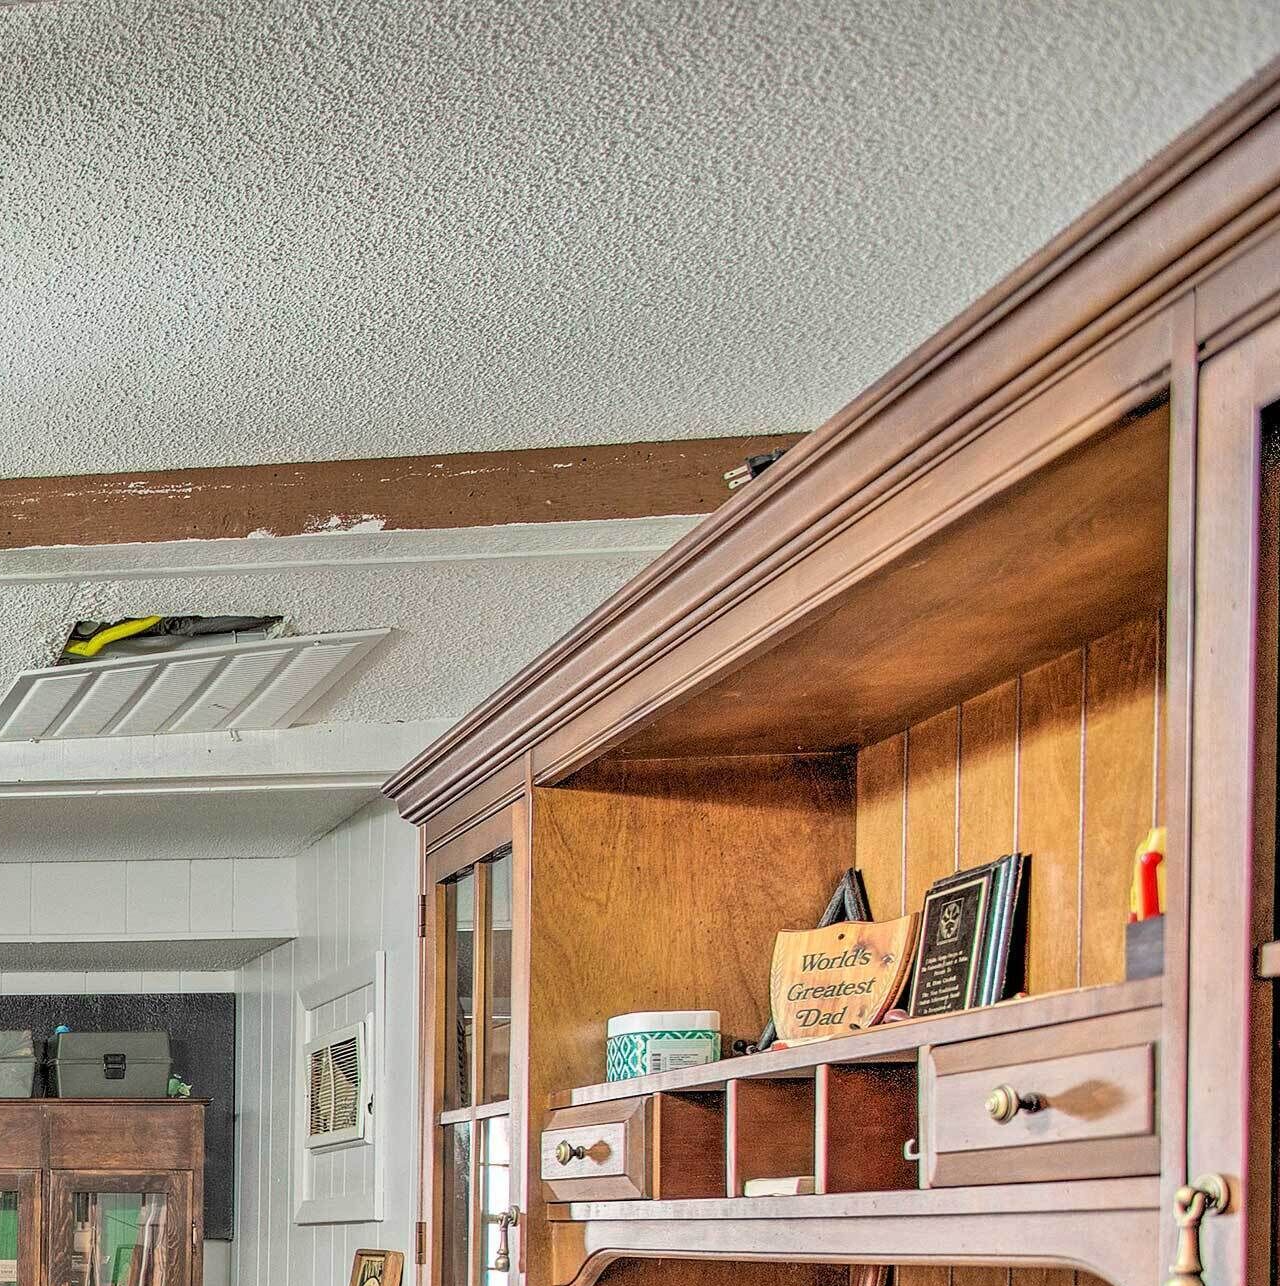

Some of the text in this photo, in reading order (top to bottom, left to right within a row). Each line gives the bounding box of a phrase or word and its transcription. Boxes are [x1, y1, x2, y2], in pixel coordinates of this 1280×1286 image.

[801, 950, 872, 972] World's
[786, 977, 876, 1002] Greatest
[795, 1006, 848, 1028] Dad
